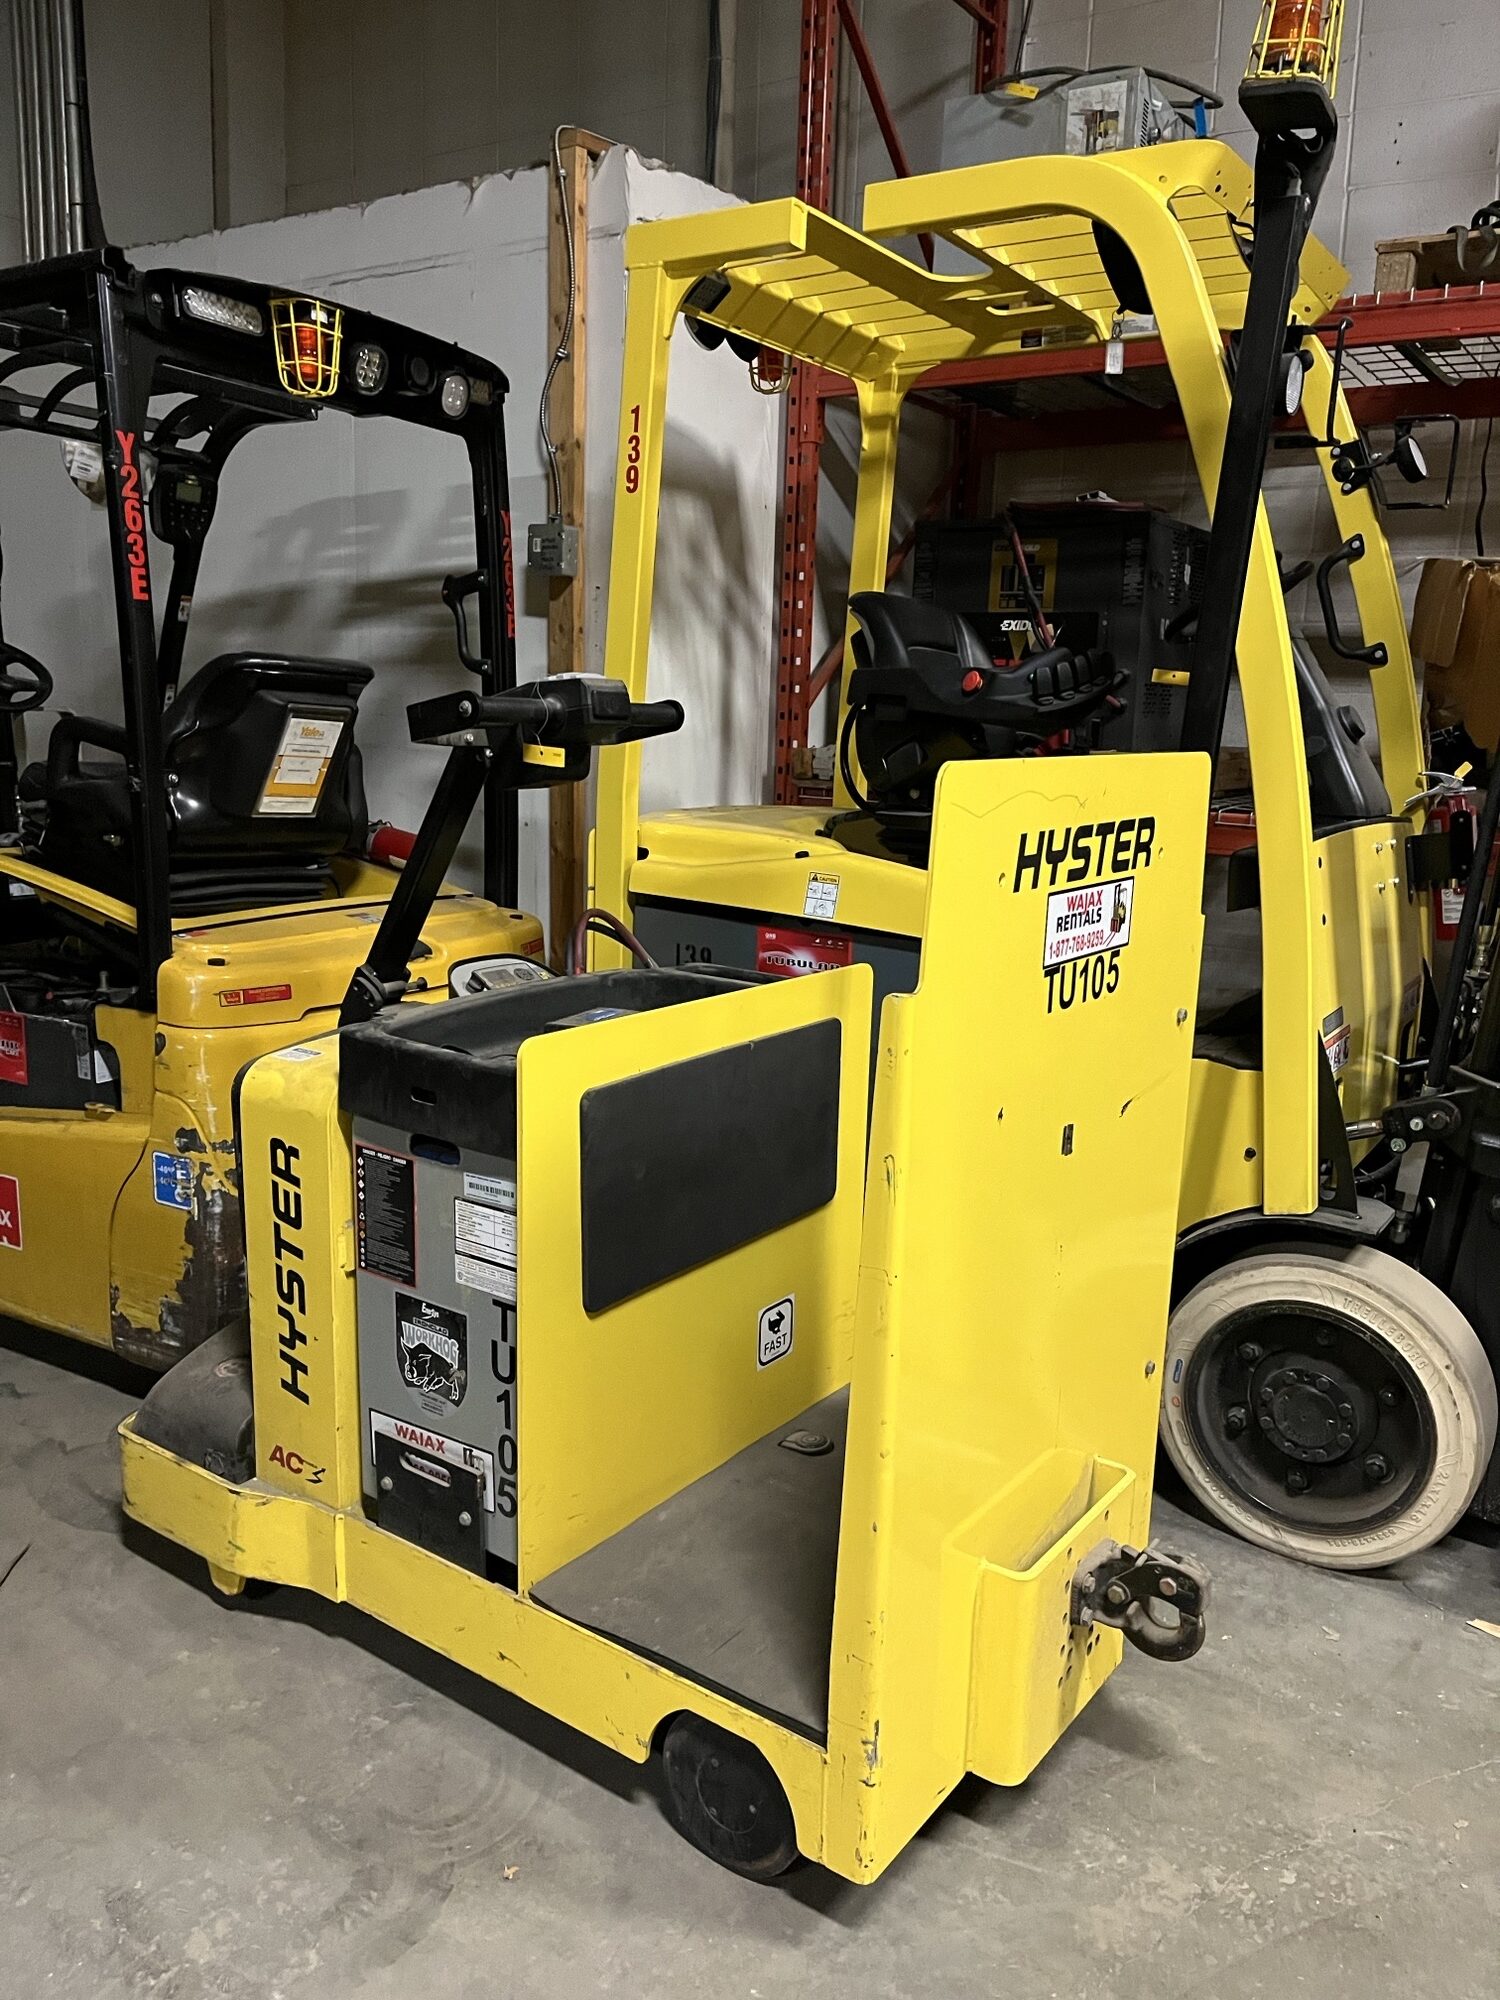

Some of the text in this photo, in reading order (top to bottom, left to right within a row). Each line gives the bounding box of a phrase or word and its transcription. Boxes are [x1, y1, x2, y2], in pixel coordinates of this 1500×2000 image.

[626, 404, 641, 494] 139
[115, 430, 149, 601] Y263E
[1000, 619, 1032, 631] EXID
[1013, 816, 1156, 894] HYSTER
[1056, 907, 1103, 934] RENTALS
[1066, 889, 1104, 915] WAJAX
[1049, 929, 1105, 960] 1-877-768-9259
[1043, 949, 1121, 1014] TU105
[269, 1136, 310, 1406] HYSTER
[401, 1321, 460, 1369] WORKHOG
[764, 1332, 788, 1356] FAST
[1342, 1297, 1429, 1371] TRELLEBORG
[491, 1298, 518, 1519] TU105
[268, 1444, 304, 1474] AC
